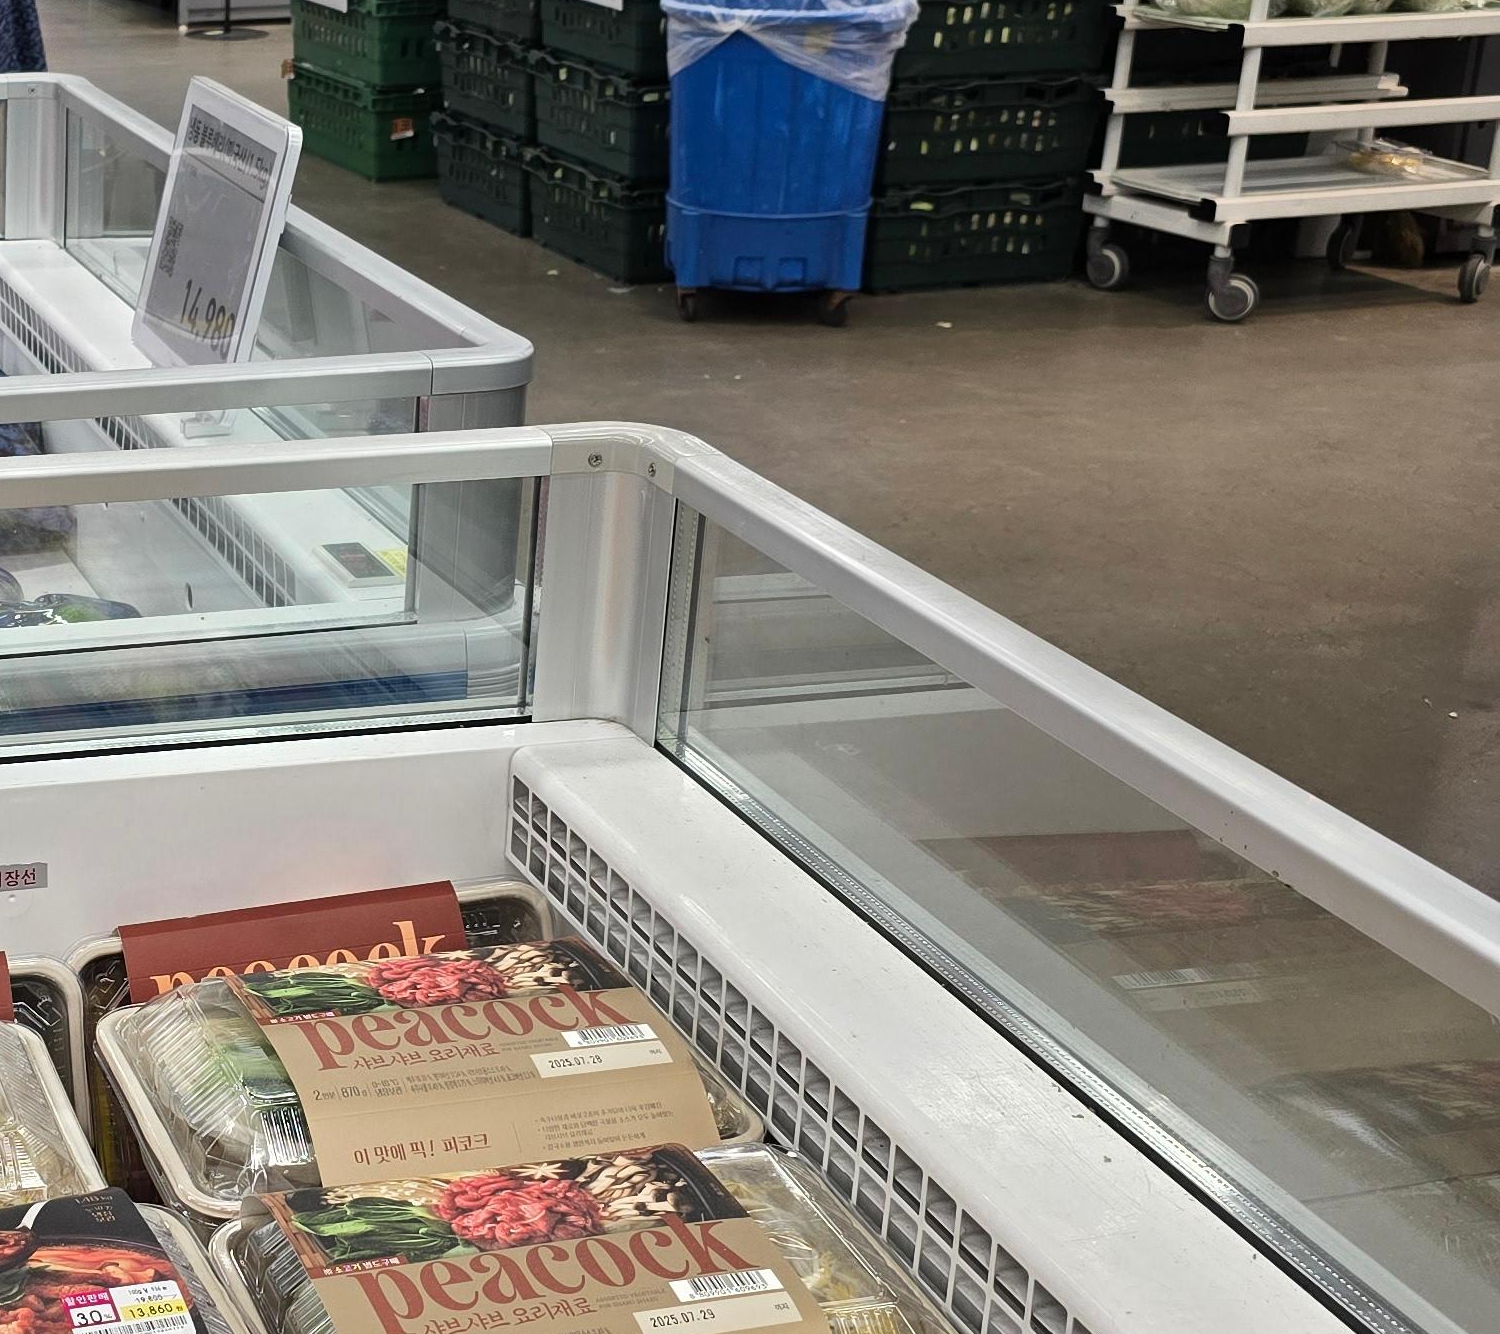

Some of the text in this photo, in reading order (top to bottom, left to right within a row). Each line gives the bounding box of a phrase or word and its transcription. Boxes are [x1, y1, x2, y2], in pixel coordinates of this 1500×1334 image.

[296, 983, 639, 1071] peacock
[353, 1042, 500, 1071] 샤브샤브 요리재료
[549, 1055, 603, 1069] 2025.07.28
[354, 1133, 491, 1165] 이 맛에 픽! 피코크
[64, 1291, 110, 1308] 할인판매
[513, 1298, 598, 1326] 요리재료
[650, 1309, 716, 1328] 2025.07.29
